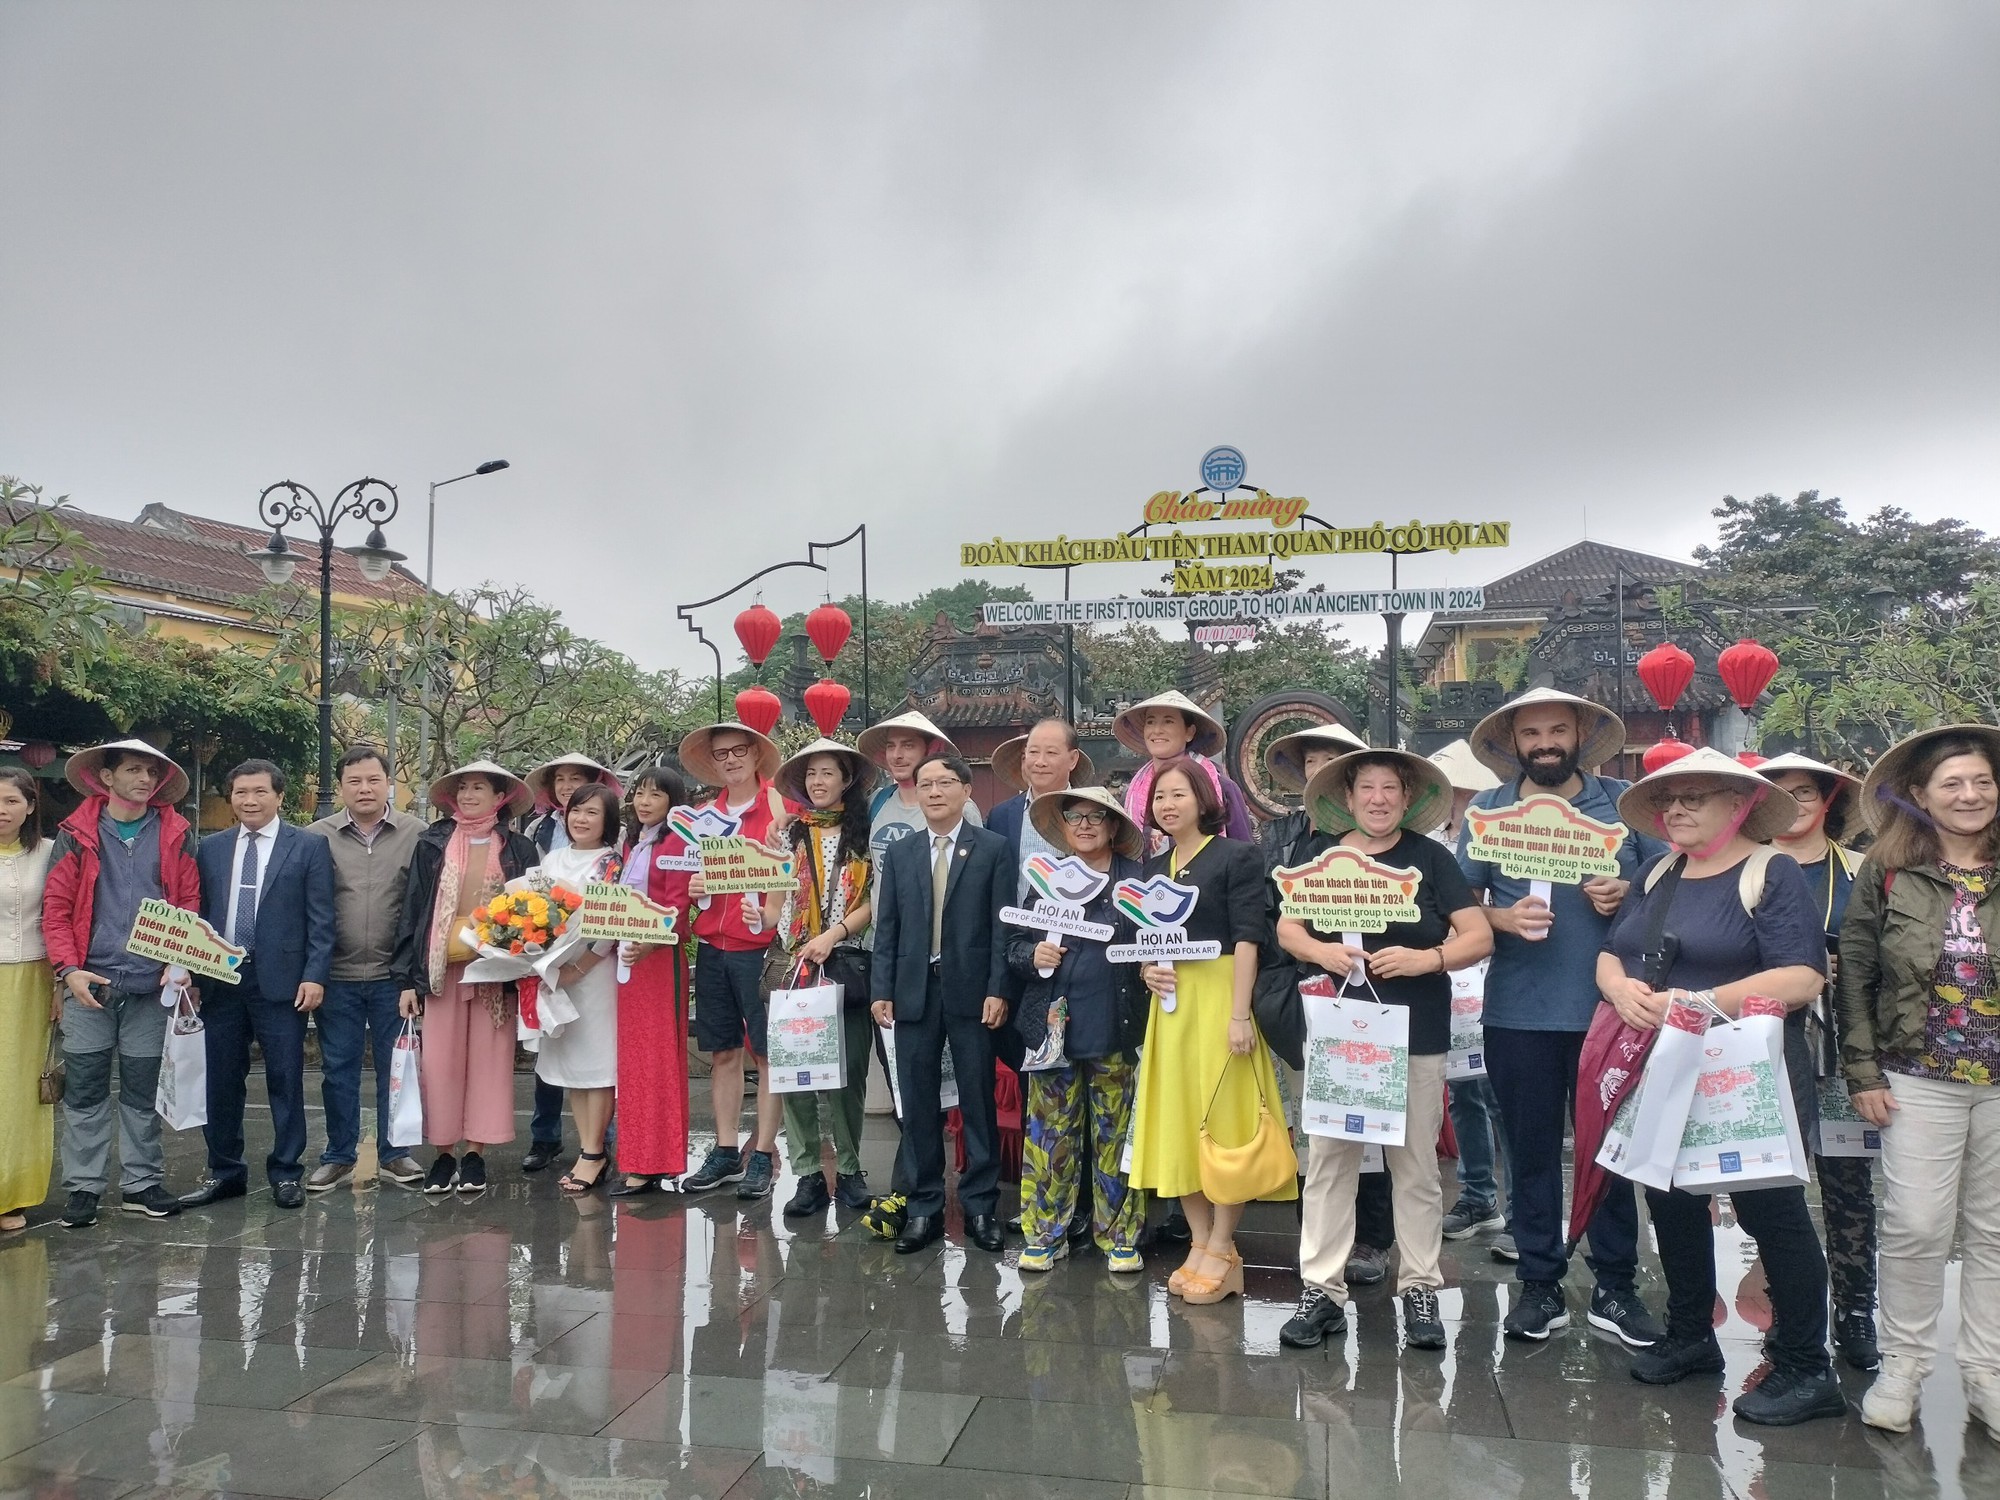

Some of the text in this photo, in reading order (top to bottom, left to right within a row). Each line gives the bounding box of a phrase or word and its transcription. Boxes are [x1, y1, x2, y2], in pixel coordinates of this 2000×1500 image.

[1146, 492, 1302, 526] Chào mừng
[964, 522, 1508, 564] ĐOÀN KHÁCH ĐẦU TIÊN THAM QUAN PHỐ CỔ HỘI AN
[1177, 565, 1271, 589] NĂM 2024
[986, 604, 1052, 622] WELCOME
[1056, 603, 1082, 621] THE
[1086, 602, 1122, 619] FIRST
[1126, 600, 1185, 618] TOURIST
[1189, 599, 1237, 617] GROUP
[1243, 598, 1259, 615] TO
[1292, 596, 1311, 613] AN
[1316, 594, 1379, 613] ANCIENT
[1382, 592, 1426, 610] TOWN
[1431, 592, 1444, 609] IN
[1449, 590, 1482, 608] 2024
[1197, 627, 1254, 641] 01/01/2024
[1499, 821, 1591, 841] Đoàn khách đầu tiên
[702, 837, 742, 852] HỘI AN
[1482, 833, 1605, 858] đến tham quan Hội An 2024
[1471, 847, 1615, 872] The first tourist group to visit
[1506, 863, 1576, 879] Hội An in 2024
[586, 883, 628, 897] HỘI AN
[1304, 876, 1388, 888] Đoàn khách đầu tiên
[1292, 891, 1404, 906] đến tham quan Hội An 2024
[143, 902, 194, 924] HỘI AN
[1061, 909, 1080, 920] AN
[1284, 906, 1300, 914] The
[1303, 906, 1320, 914] first
[1322, 907, 1351, 915] tourist
[1354, 909, 1381, 918] group
[1395, 909, 1415, 917] visit
[1031, 917, 1058, 926] CRAFTS
[1075, 925, 1093, 933] FOLK
[1317, 918, 1381, 928] Hội An in 2024
[1166, 933, 1182, 944] AN
